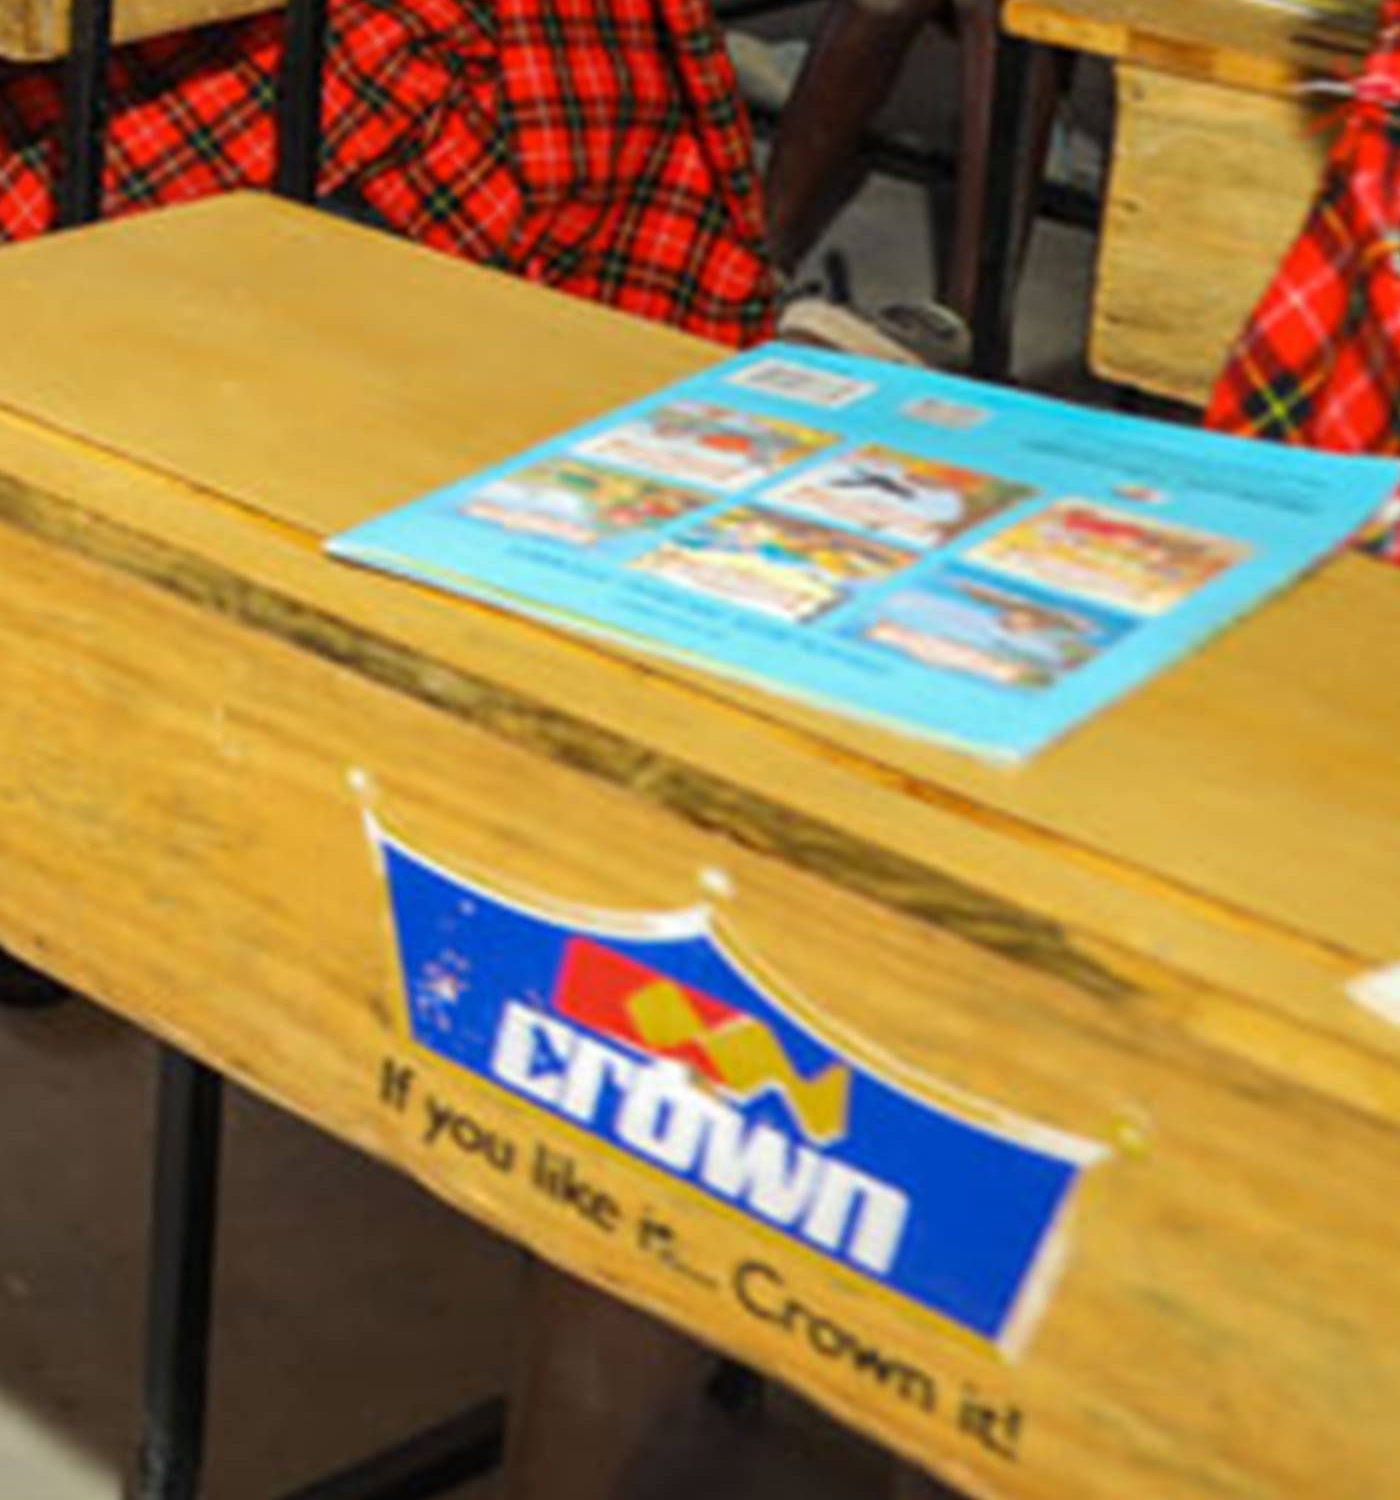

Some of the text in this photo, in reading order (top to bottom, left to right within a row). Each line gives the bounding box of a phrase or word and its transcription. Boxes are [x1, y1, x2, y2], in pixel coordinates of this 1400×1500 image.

[380, 1057, 414, 1113] If
[422, 1096, 516, 1173] you
[531, 1139, 621, 1232] like
[733, 1259, 936, 1414] Crown
